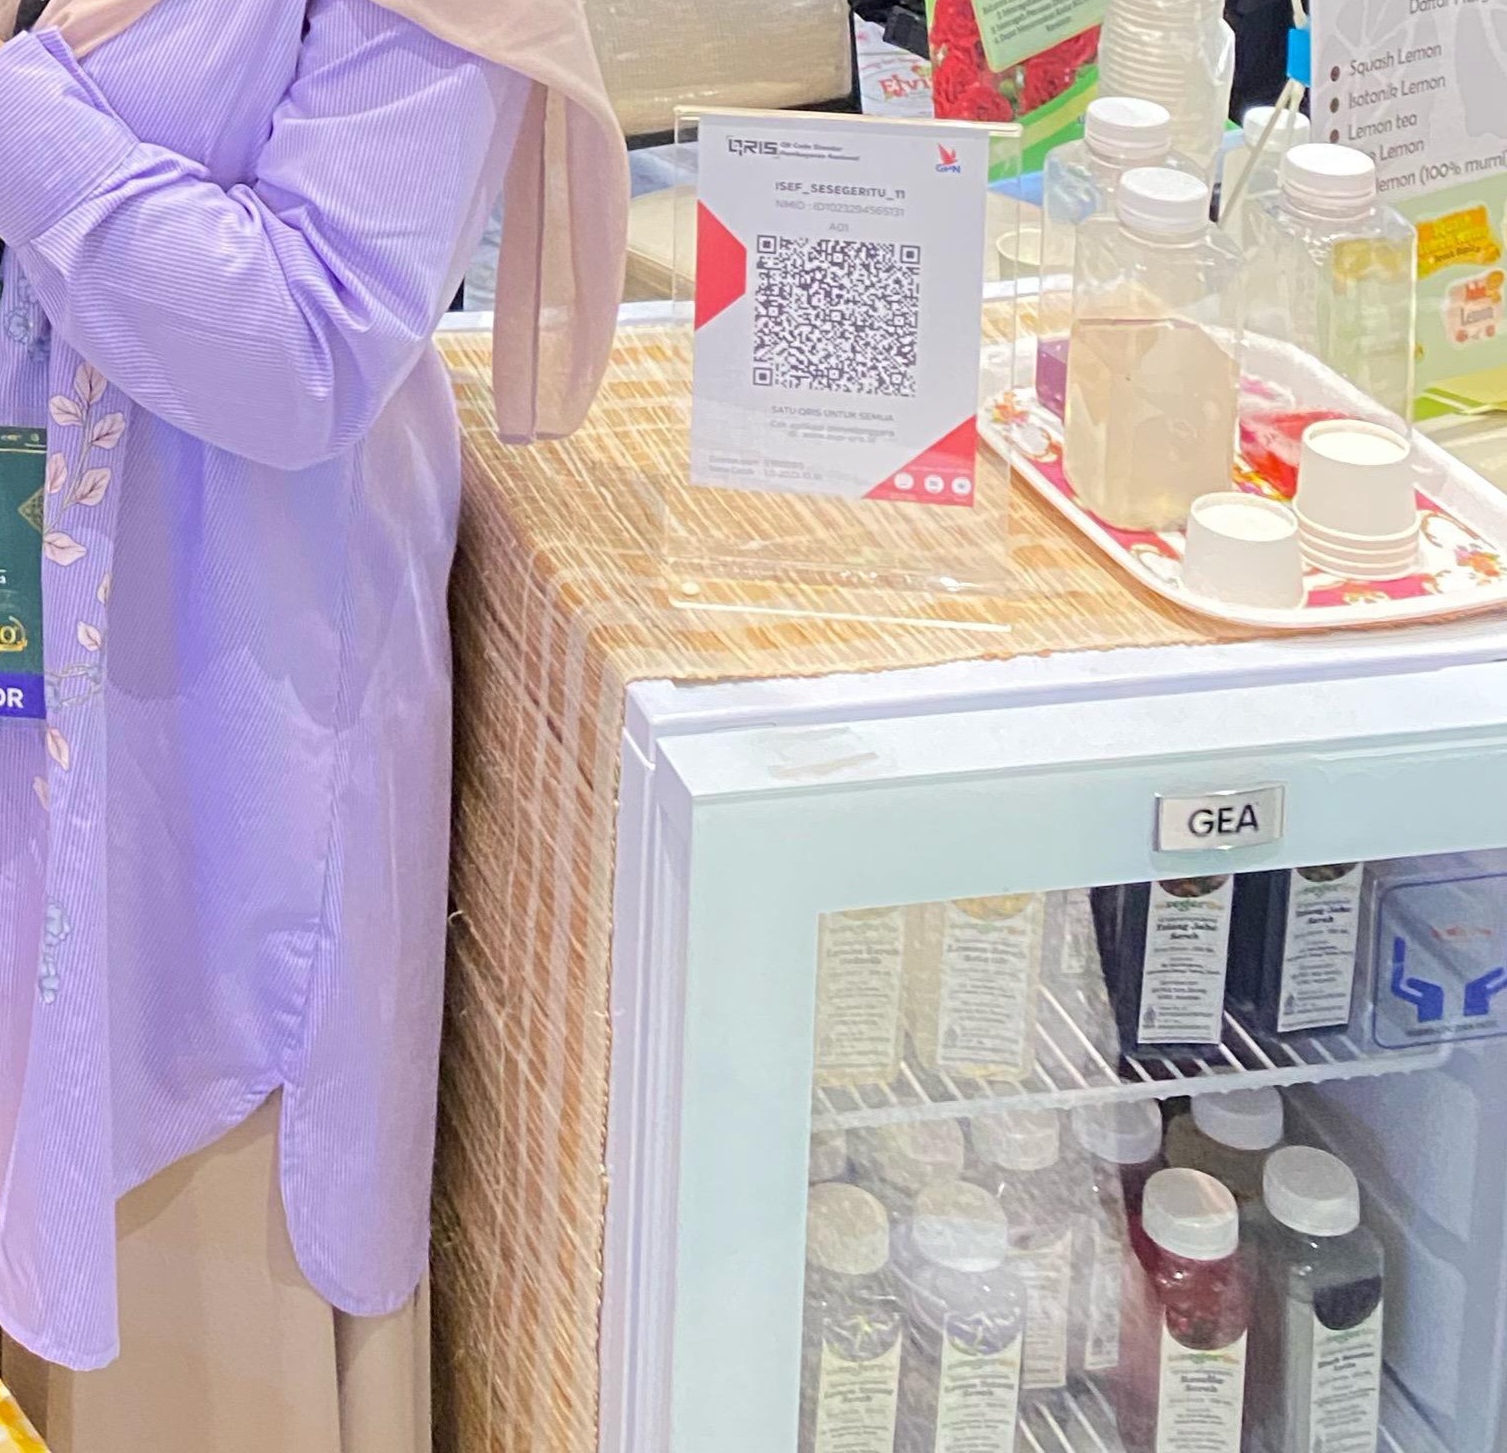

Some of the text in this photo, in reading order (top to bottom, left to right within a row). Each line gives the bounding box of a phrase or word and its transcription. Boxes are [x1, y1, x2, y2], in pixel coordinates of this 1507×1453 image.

[1349, 44, 1443, 78] Squash Lemon
[1348, 74, 1447, 110] Isotonik Lemon
[1348, 112, 1418, 141] Lemon tea
[727, 138, 779, 156] QRIS
[1379, 138, 1425, 162] Lemon
[1419, 160, 1463, 186] (100%
[774, 181, 907, 200] ISEF_SESEGERITU_11
[828, 222, 850, 233] A01
[771, 405, 796, 416] SATU
[823, 408, 858, 420] UNTUK
[1188, 804, 1260, 837] GEA
